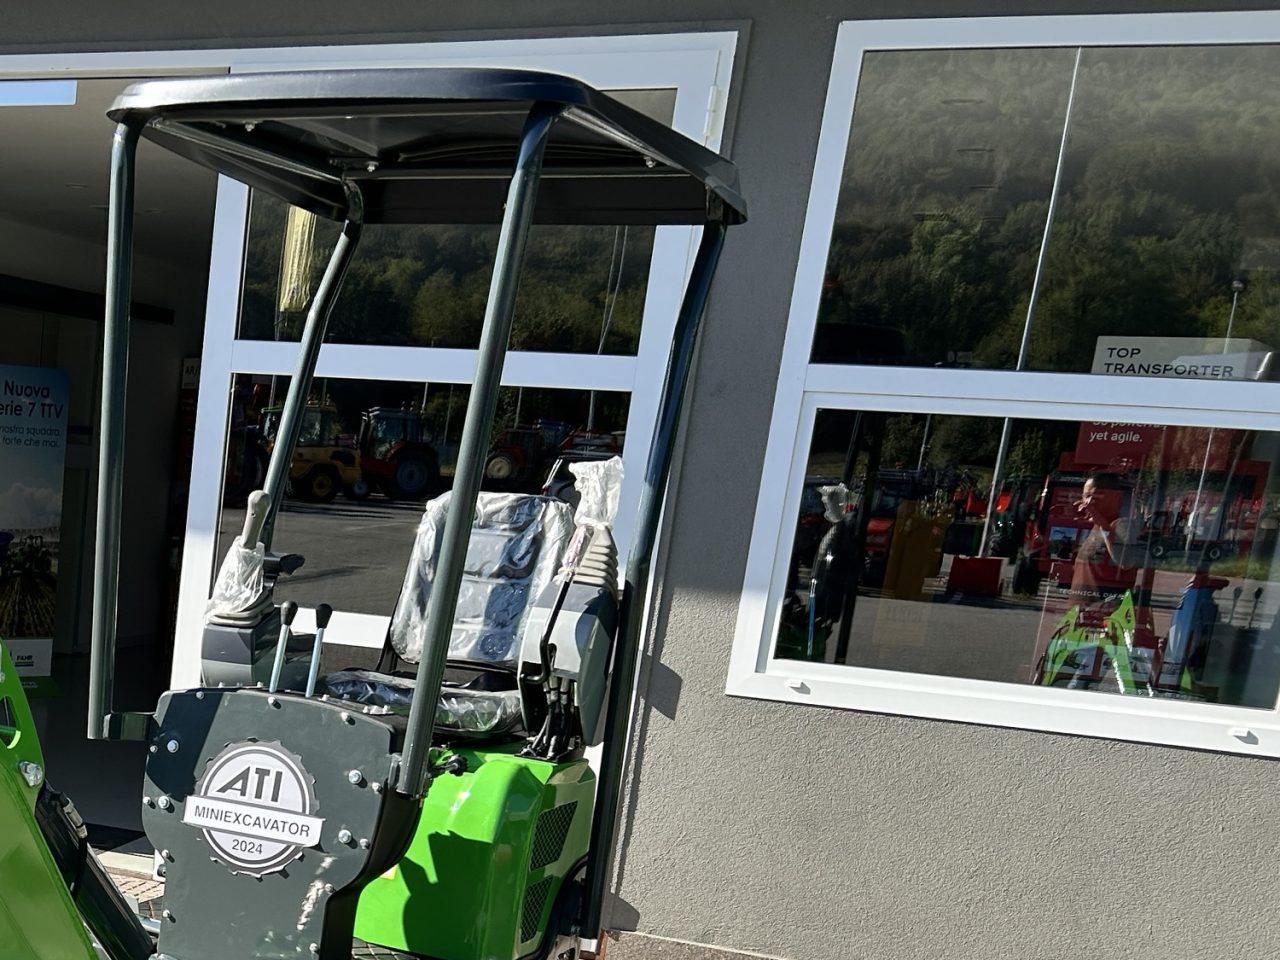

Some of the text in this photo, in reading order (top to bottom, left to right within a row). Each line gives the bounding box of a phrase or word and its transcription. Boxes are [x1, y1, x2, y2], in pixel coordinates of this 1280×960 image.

[1107, 347, 1141, 359] TOP
[1104, 363, 1234, 377] TRANSPORTER
[4, 380, 50, 398] Nuova
[28, 402, 36, 417] 7
[40, 402, 64, 419] TTV
[1, 436, 23, 446] forte
[23, 437, 41, 447] che
[1088, 431, 1143, 443] yet agile.
[1059, 588, 1101, 597] TECHNICAL
[215, 765, 284, 804] ATI
[194, 804, 311, 838] MINIEXCAVATOR
[231, 838, 263, 855] 2024
